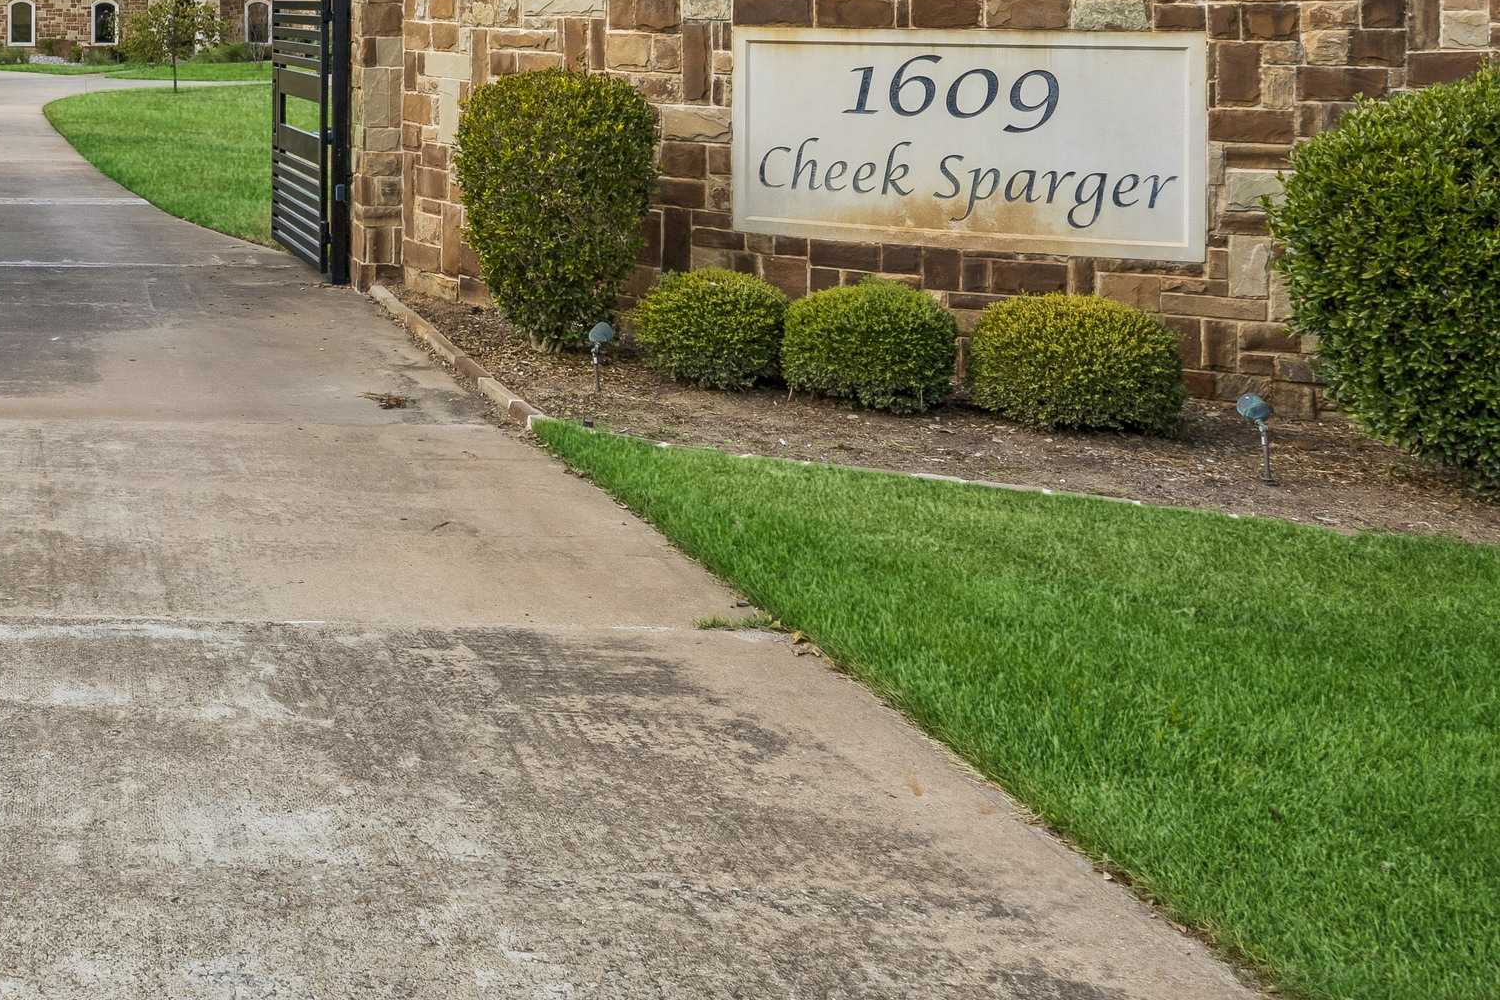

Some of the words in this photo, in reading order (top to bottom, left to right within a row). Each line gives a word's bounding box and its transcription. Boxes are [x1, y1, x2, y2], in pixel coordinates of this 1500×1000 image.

[841, 54, 1060, 134] 1609
[758, 137, 914, 197] Cheek
[932, 154, 1179, 229] Sparger
